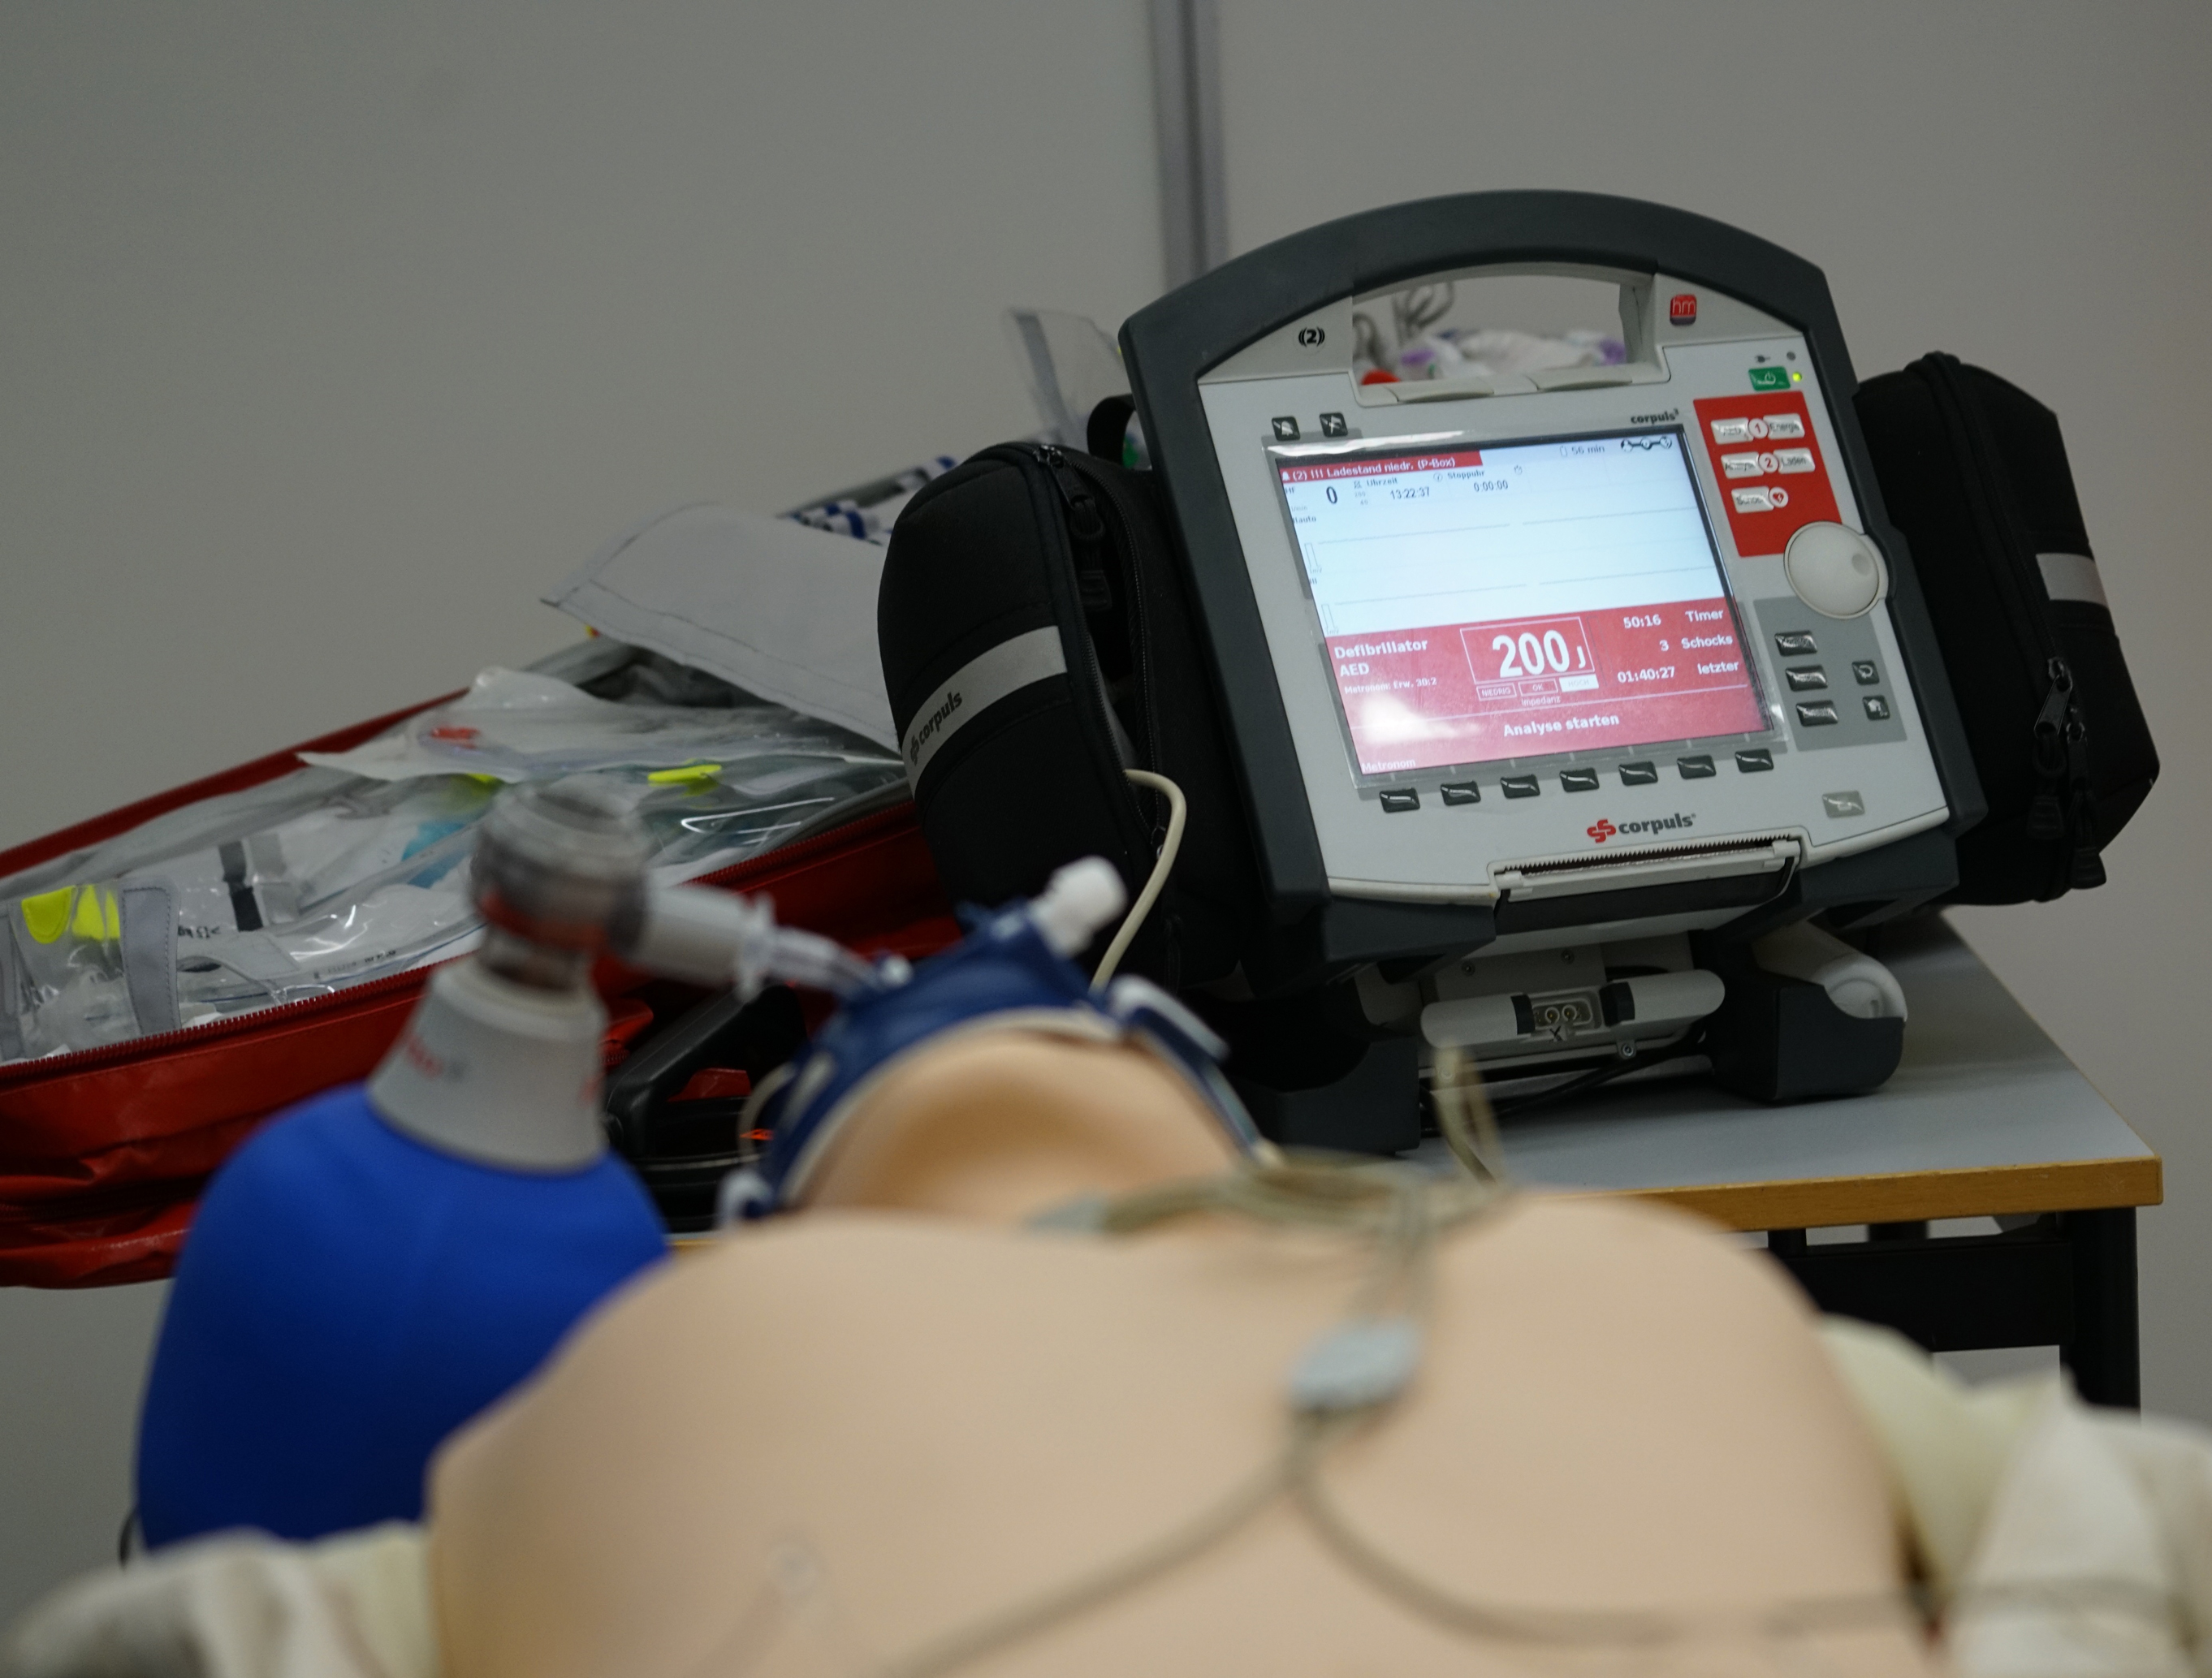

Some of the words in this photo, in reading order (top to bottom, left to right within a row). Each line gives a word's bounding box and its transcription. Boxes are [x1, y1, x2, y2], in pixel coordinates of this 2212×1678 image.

[1755, 423, 1761, 434] 1
[1571, 446, 1584, 455] 56
[1588, 444, 1605, 454] min
[1327, 463, 1382, 478] Ladestand
[1384, 460, 1414, 472] niedr.
[1417, 457, 1456, 470] (P-Box)
[1765, 458, 1773, 468] 2
[1447, 469, 1485, 480] Stoppuhr
[1367, 477, 1398, 487] Uhrzeit
[1474, 480, 1509, 492] 0:00:00
[1326, 485, 1338, 504] 0
[1390, 486, 1430, 500] 13:22:37
[1623, 614, 1661, 629] 50:16
[1685, 610, 1724, 623] Timer
[1333, 640, 1428, 659] Defibrillator
[1659, 640, 1670, 652] 3
[1681, 634, 1733, 649] Schocks
[1492, 629, 1570, 679] 200
[1340, 662, 1370, 677] AED
[1617, 666, 1675, 684] 01:40:27
[1697, 661, 1739, 675] letzter
[1416, 677, 1437, 687] 30:2
[1532, 684, 1544, 692] OK
[1481, 687, 1511, 697] NIEDRIG
[918, 691, 962, 745] corpuls
[1504, 721, 1562, 737] Analyse
[1566, 714, 1620, 730] starten
[1361, 759, 1416, 773] Metronom
